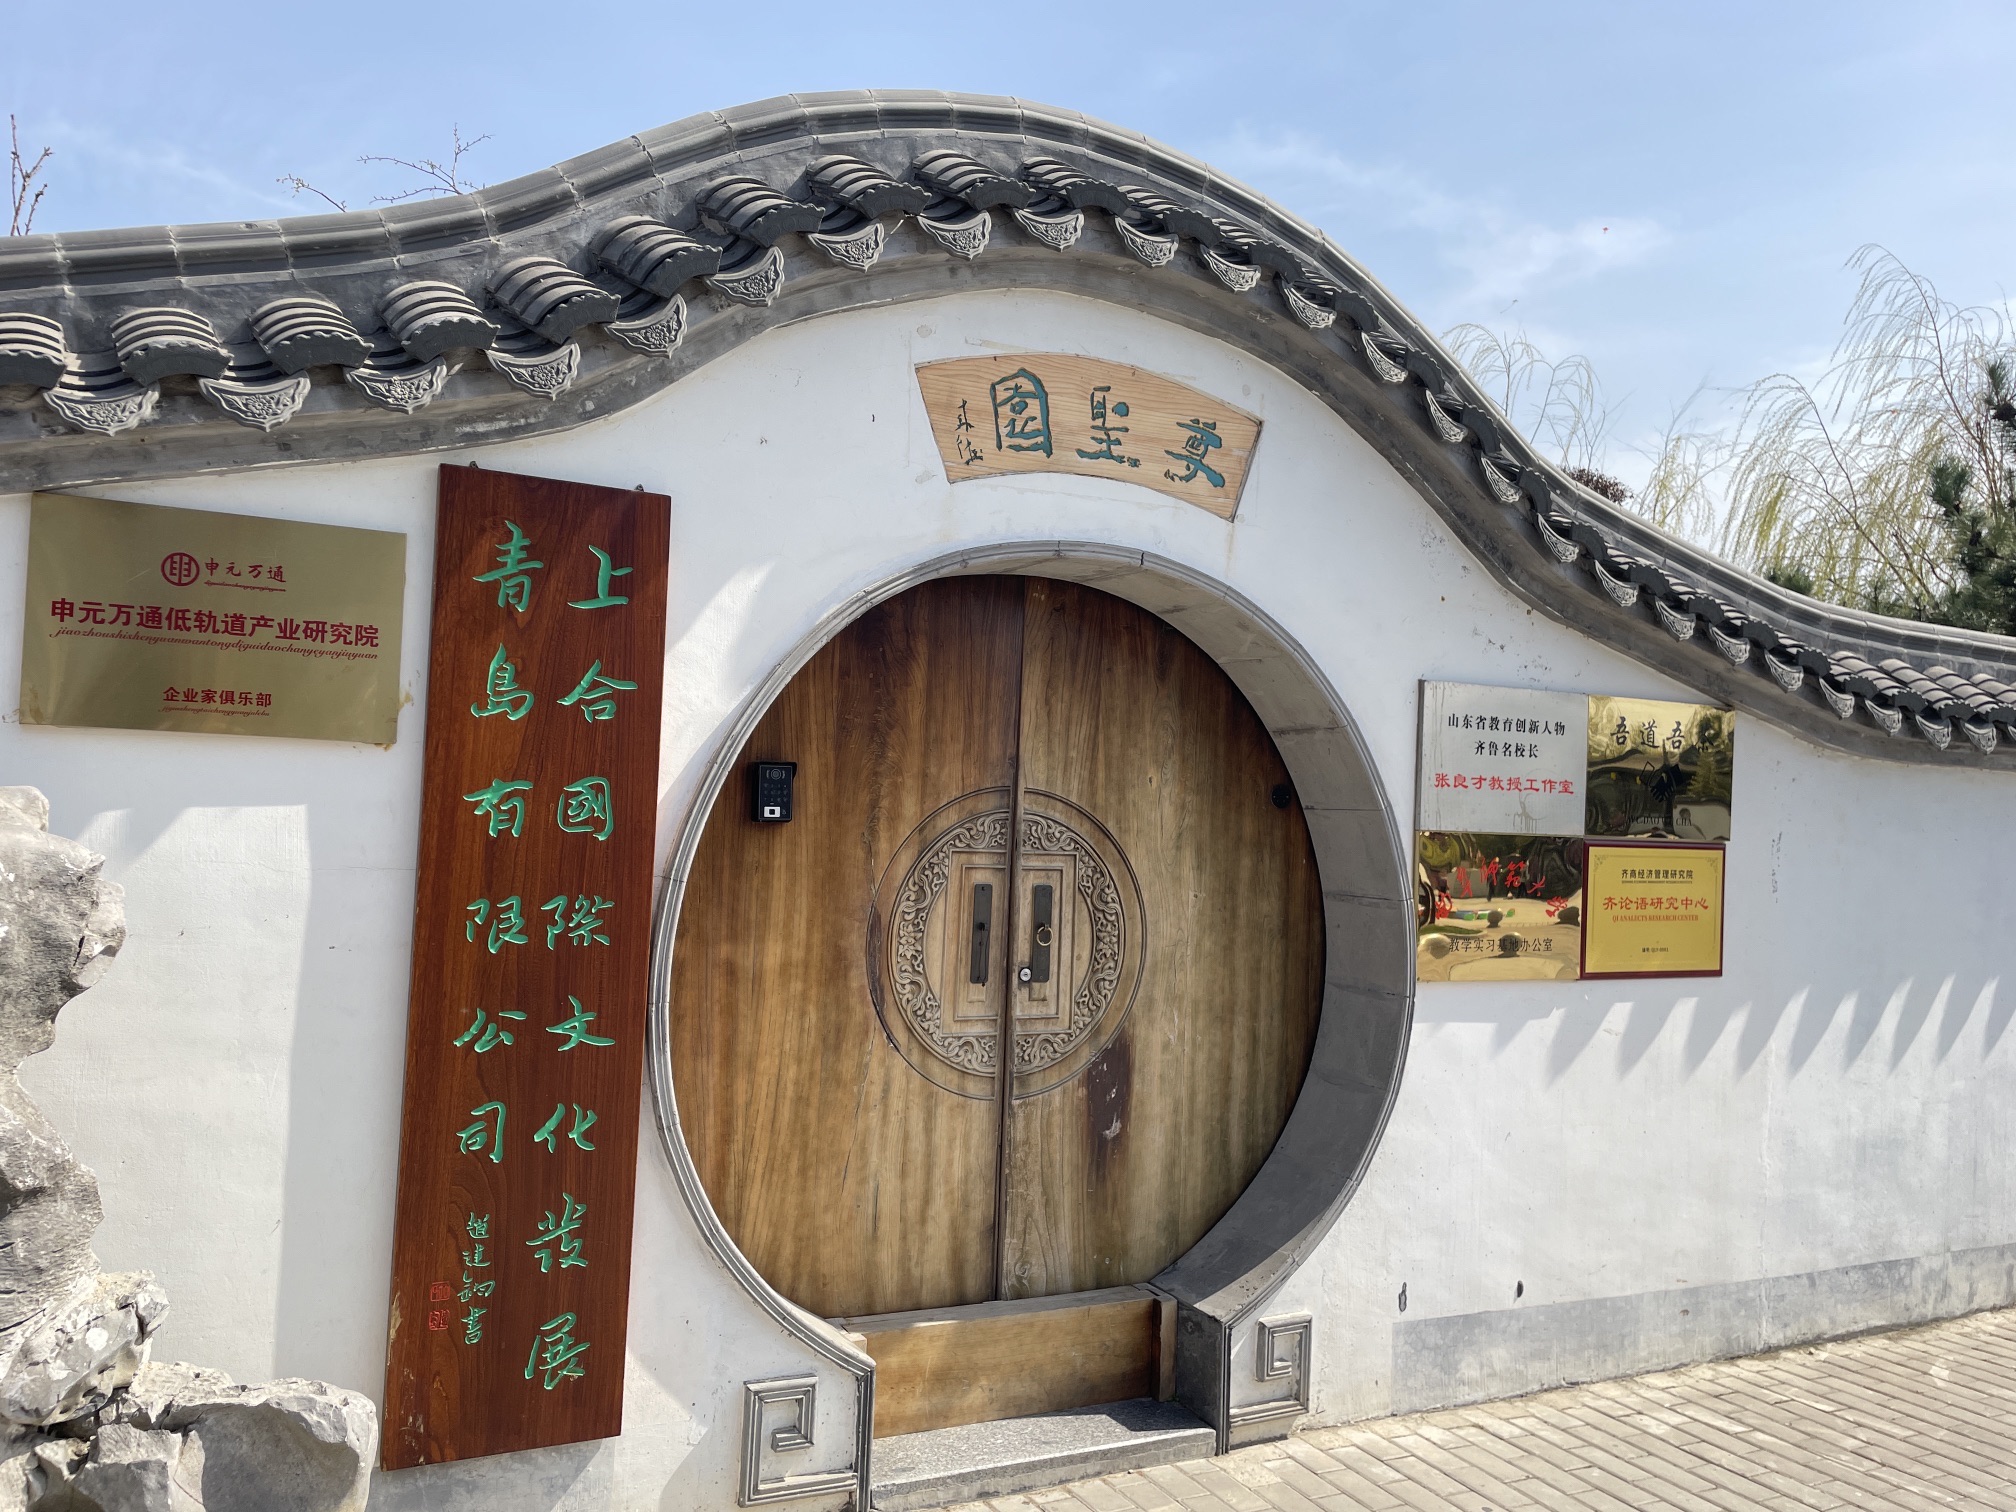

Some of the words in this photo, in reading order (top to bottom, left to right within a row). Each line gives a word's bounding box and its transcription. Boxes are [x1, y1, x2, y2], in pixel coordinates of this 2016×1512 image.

[205, 557, 287, 583] 申元万通
[51, 598, 379, 648] 申元万通低轨道产业研究院
[163, 686, 272, 708] 企业家俱乐部
[1448, 713, 1566, 736] 山东省教育创新人物
[1474, 740, 1539, 758] 齐鲁名校长
[1434, 773, 1574, 795] 张良才教授工作室
[1643, 816, 1660, 825] DAO
[1676, 818, 1692, 827] CHA
[1621, 869, 1693, 880] 齐商经济管理研究院
[1602, 896, 1709, 911] 齐论语研究中心
[1612, 914, 1619, 923] QI
[1620, 914, 1648, 922] ANALECTS
[1649, 914, 1677, 922] RESEARCH
[1677, 914, 1699, 922] CENTER
[1448, 937, 1554, 953] 教学实习基地办公室
